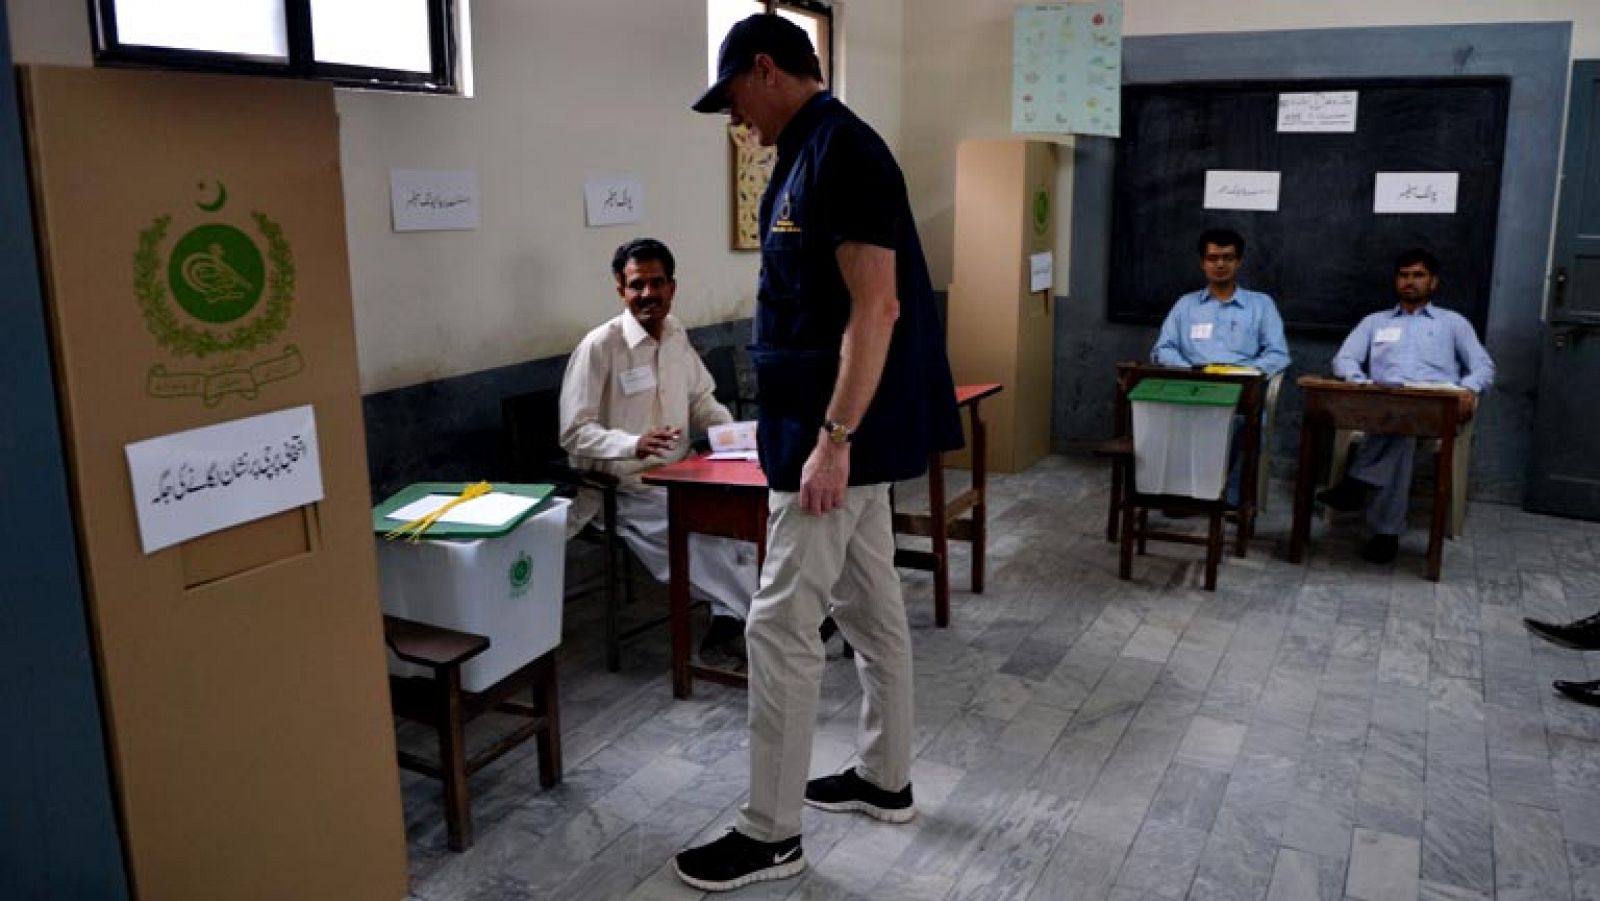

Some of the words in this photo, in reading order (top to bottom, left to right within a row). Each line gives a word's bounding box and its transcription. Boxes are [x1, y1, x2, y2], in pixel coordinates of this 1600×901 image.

[151, 468, 173, 505] جگہ
[187, 461, 217, 494] لگانے
[218, 451, 248, 487] نشان
